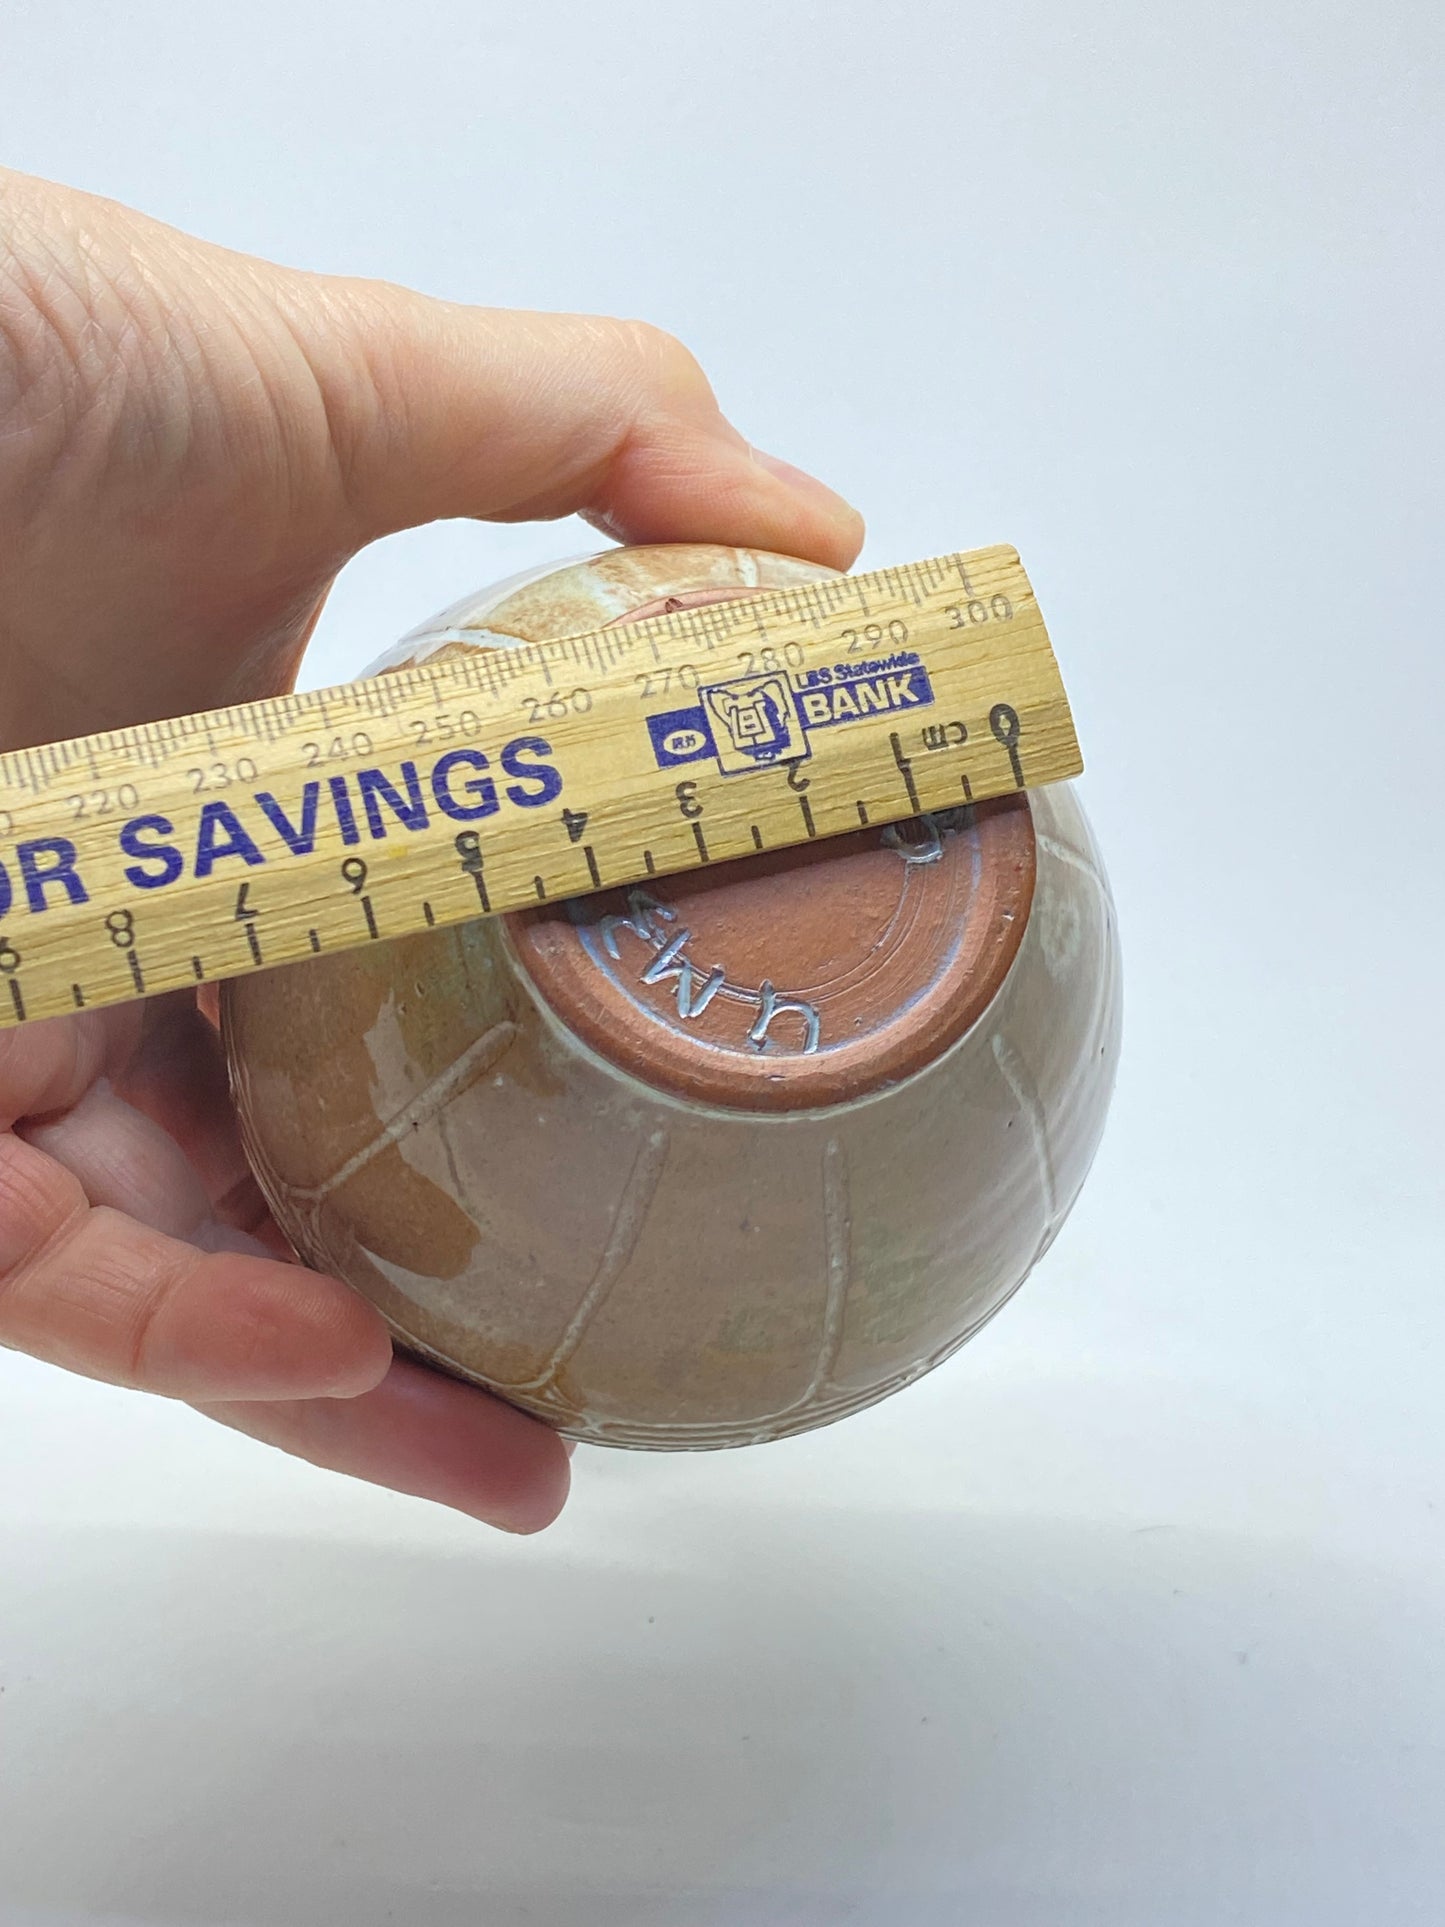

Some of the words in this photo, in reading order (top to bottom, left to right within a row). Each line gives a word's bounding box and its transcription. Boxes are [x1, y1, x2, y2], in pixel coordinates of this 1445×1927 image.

[67, 783, 140, 821] 220
[186, 757, 259, 795] 230
[301, 732, 374, 769] 240
[409, 710, 482, 747] 250
[521, 688, 594, 724] 260
[634, 664, 701, 700] 270
[737, 642, 806, 678] 280
[841, 619, 909, 654] 290
[944, 593, 1014, 630] 300
[802, 673, 919, 724] BANK
[989, 703, 1020, 746] 0
[784, 758, 810, 791] 2
[119, 736, 563, 889] SAVINGS
[675, 781, 703, 818] 3
[561, 808, 589, 842] 4
[455, 830, 484, 872] 5
[342, 857, 367, 894] 6
[234, 882, 260, 921] 7
[105, 909, 135, 948] 8
